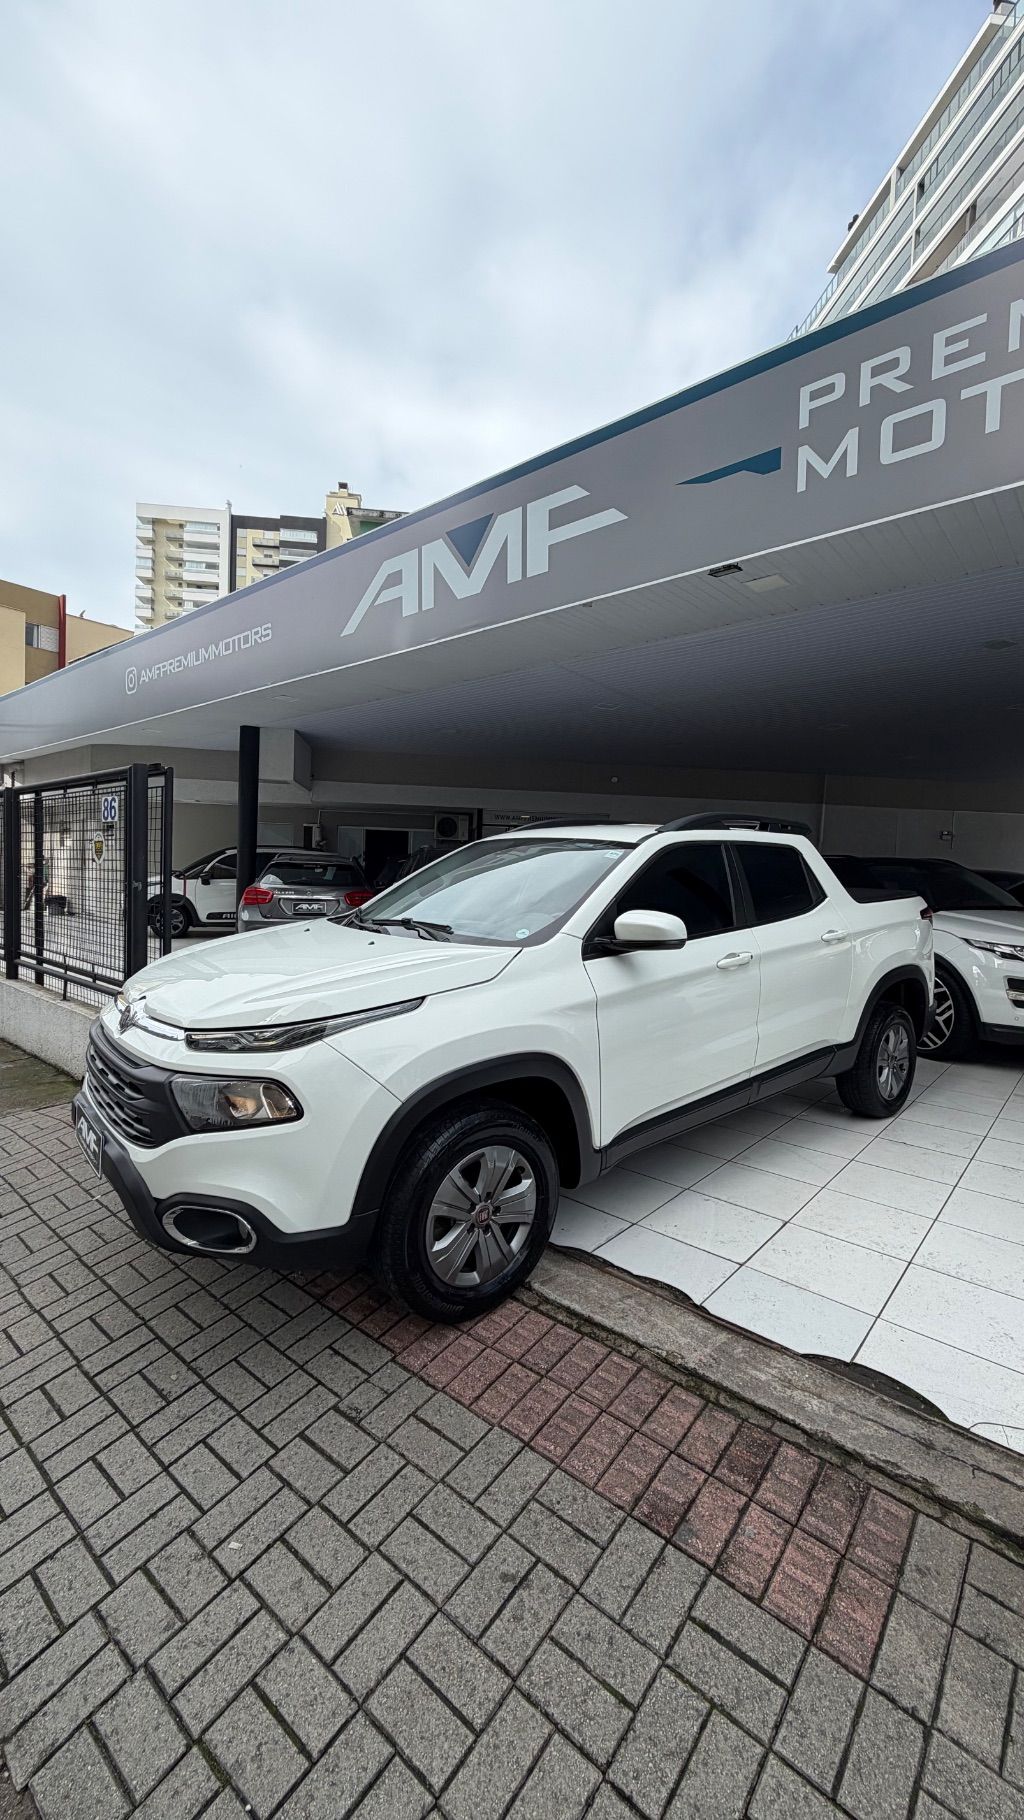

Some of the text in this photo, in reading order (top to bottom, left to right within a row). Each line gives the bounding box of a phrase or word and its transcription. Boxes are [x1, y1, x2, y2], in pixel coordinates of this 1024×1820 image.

[799, 299, 1024, 430] PRE
[340, 484, 629, 637] AMF
[139, 622, 272, 685] AMFPREMIUMMOTORS
[102, 796, 117, 821] 86
[77, 1115, 99, 1154] AMF
